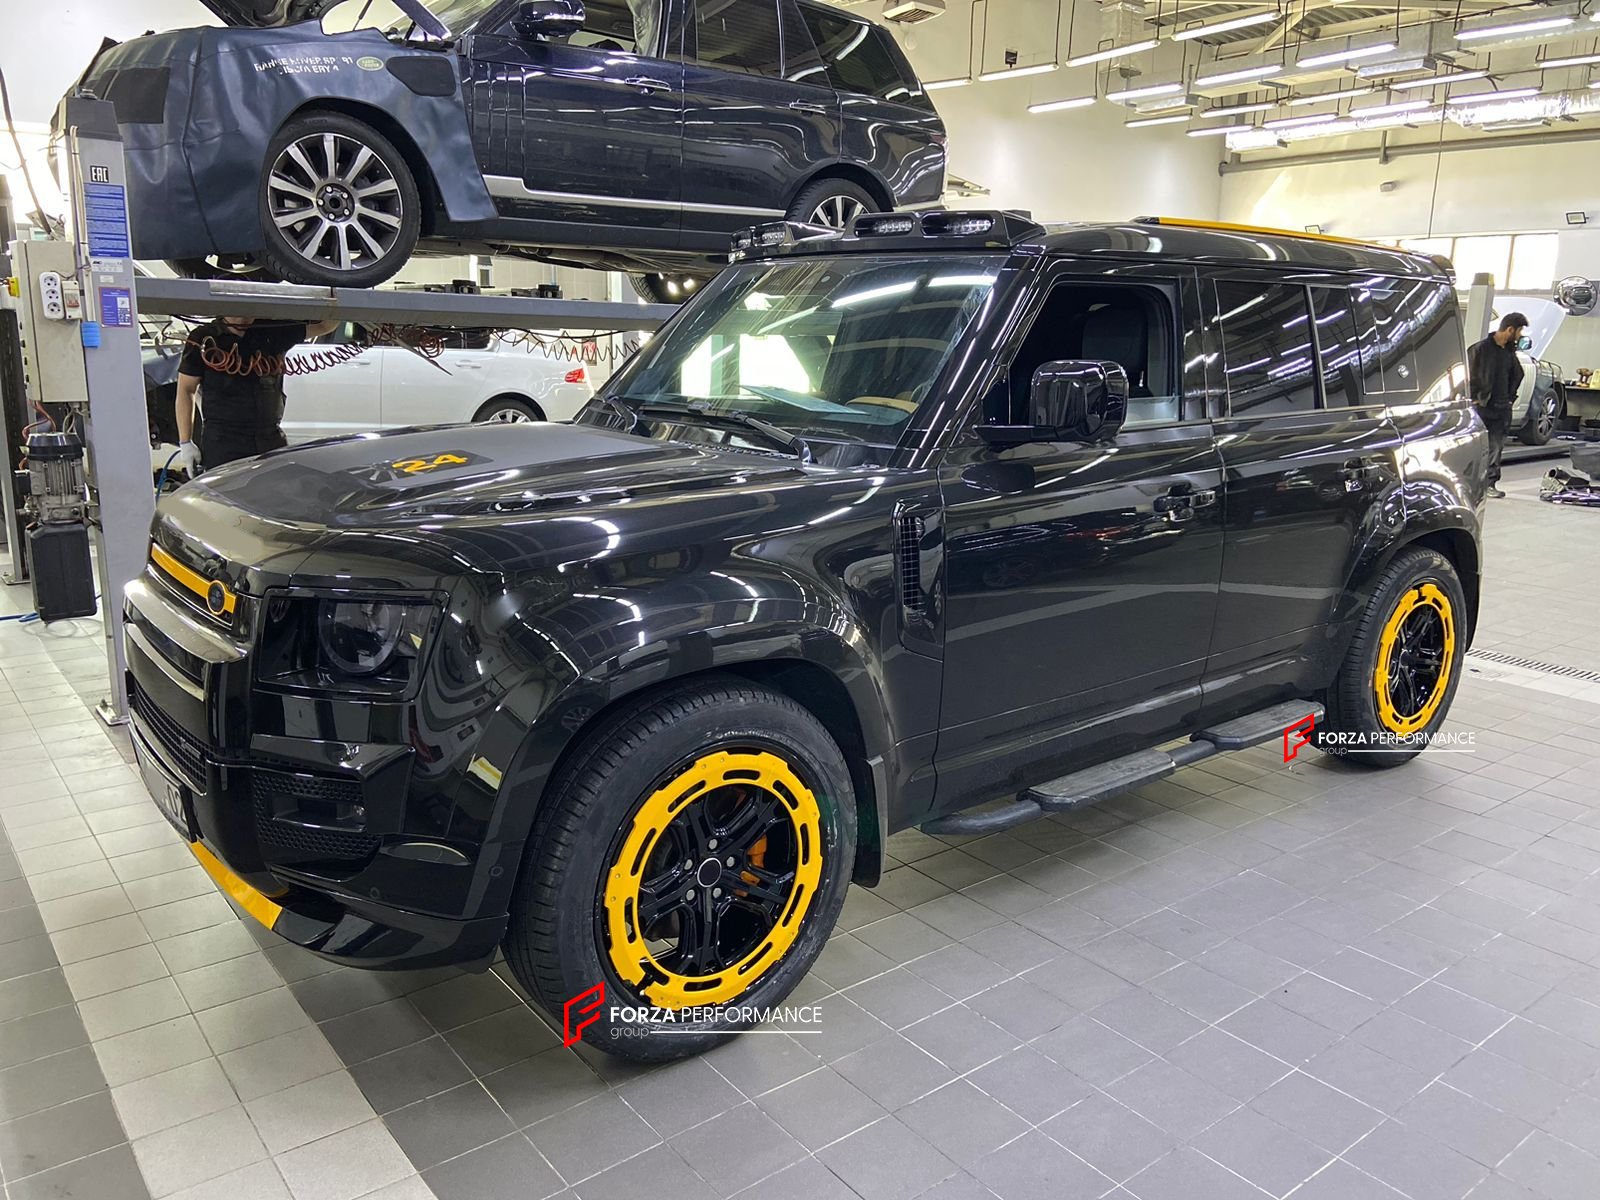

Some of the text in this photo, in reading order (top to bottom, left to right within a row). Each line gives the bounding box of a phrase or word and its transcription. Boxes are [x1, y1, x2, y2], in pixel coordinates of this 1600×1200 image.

[323, 56, 354, 65] SPRT
[279, 64, 331, 75] ISCOVERY
[91, 166, 109, 182] EAC
[391, 453, 468, 473] 24
